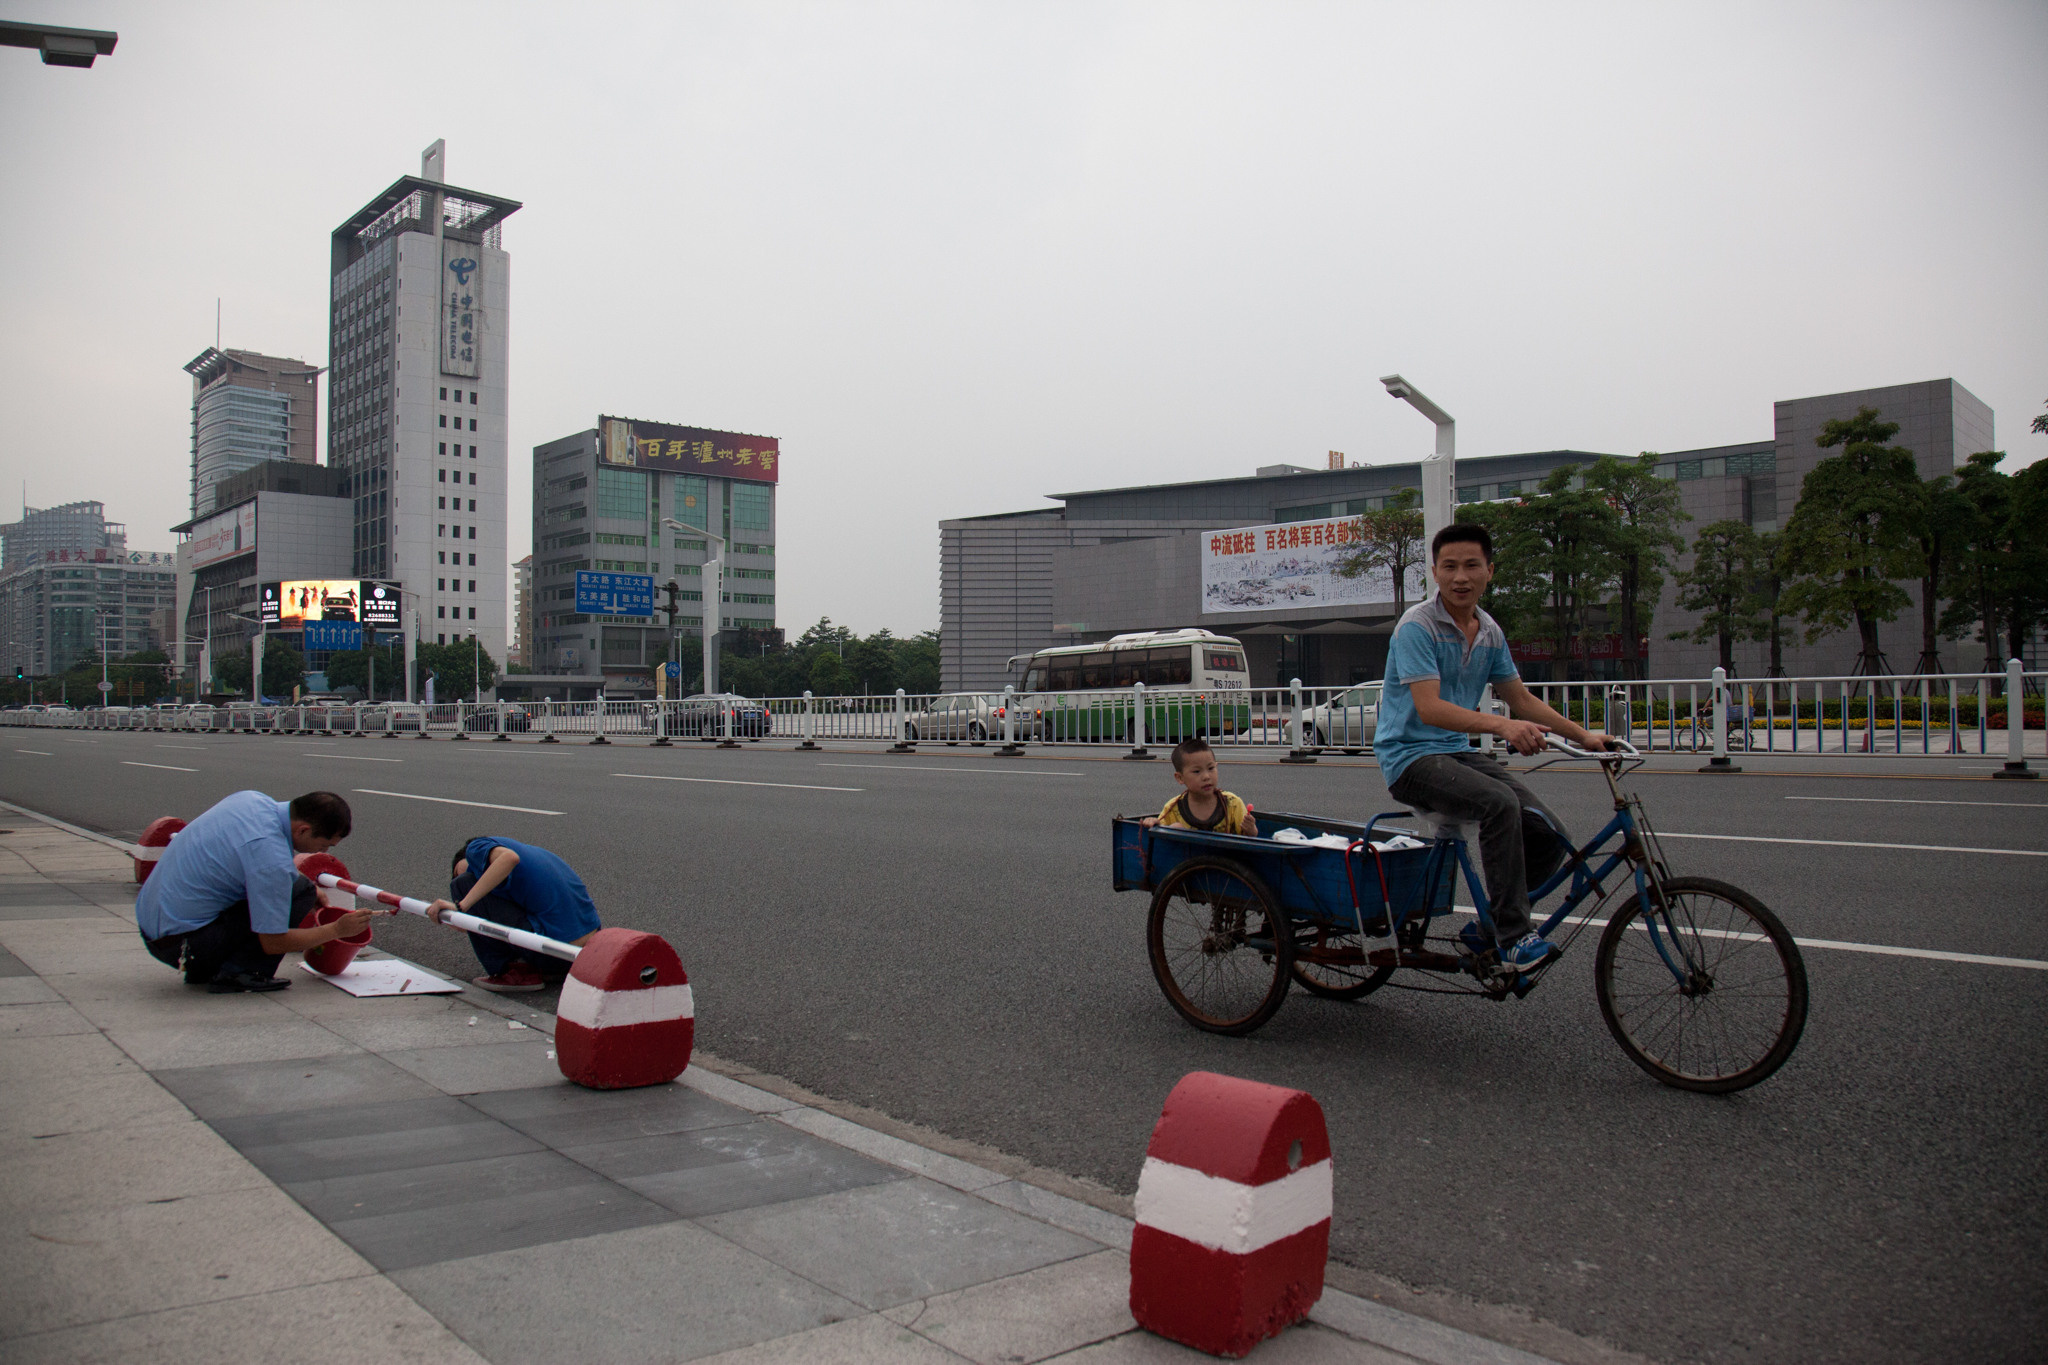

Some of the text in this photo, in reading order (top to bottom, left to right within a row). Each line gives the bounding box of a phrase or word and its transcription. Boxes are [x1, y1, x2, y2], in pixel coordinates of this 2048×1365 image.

[450, 292, 458, 319] CHINA
[460, 293, 473, 363] 中国电信
[1210, 531, 1256, 557] 中流砥柱
[46, 548, 108, 563] 鸿基大厦
[581, 574, 649, 588] 莞太路 东江大道
[579, 591, 650, 604] 元美路 胜和路
[1224, 680, 1243, 689] 72612
